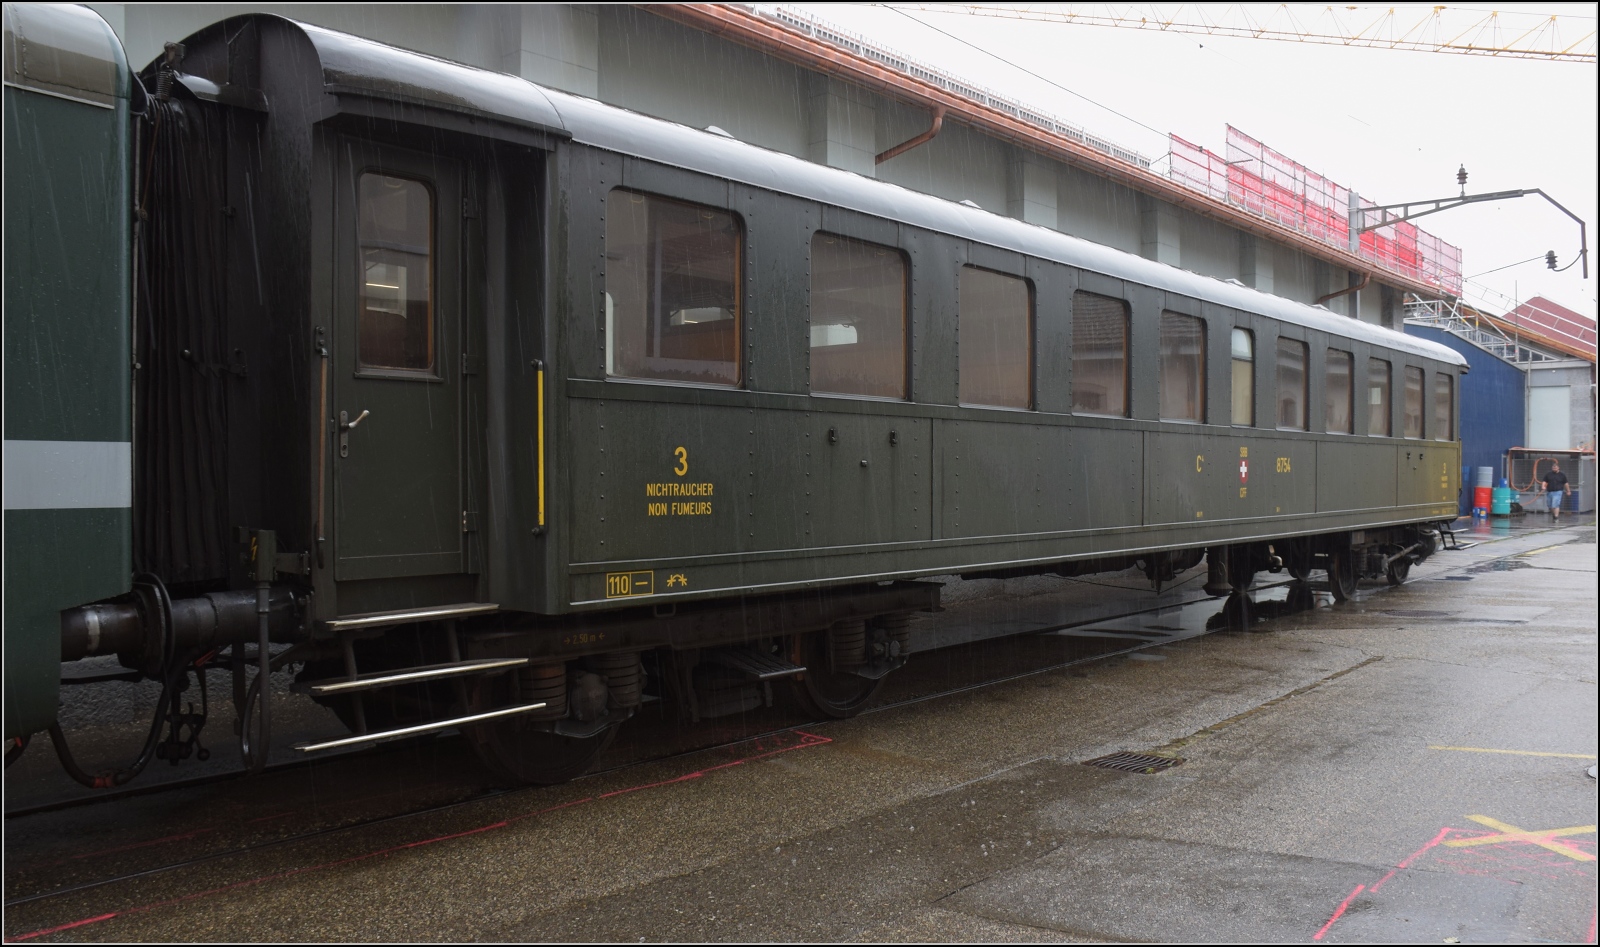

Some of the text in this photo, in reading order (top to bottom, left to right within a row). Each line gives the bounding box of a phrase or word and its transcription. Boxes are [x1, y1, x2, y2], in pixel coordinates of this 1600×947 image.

[674, 446, 688, 476] 3
[1276, 457, 1291, 473] 8754
[646, 483, 714, 497] NICHTRAUCHER
[648, 502, 712, 516] NON FUMEURS
[609, 575, 629, 595] 110
